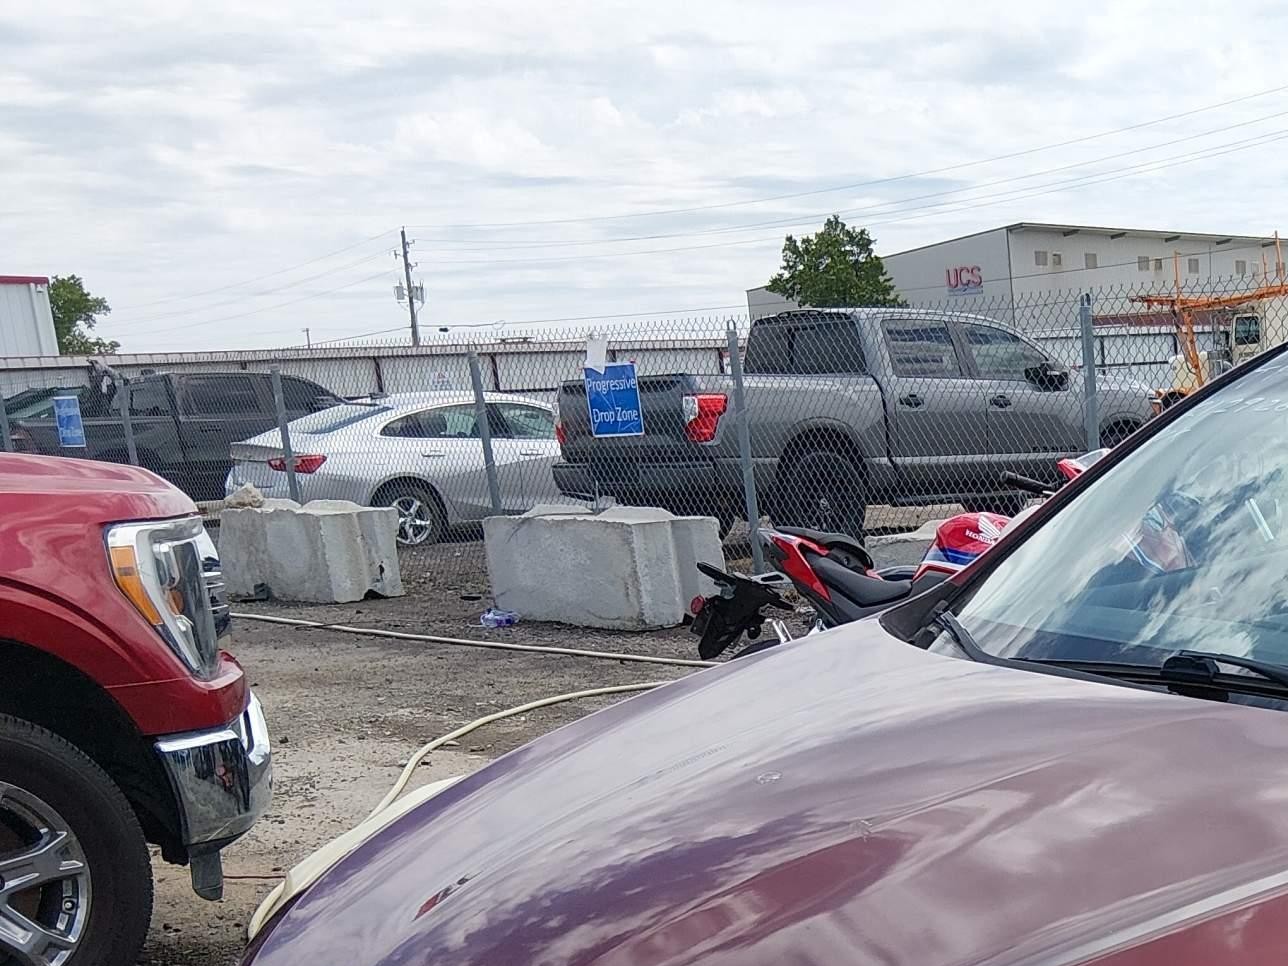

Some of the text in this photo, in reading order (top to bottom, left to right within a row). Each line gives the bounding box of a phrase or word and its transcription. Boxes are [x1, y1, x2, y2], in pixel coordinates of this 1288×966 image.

[946, 265, 983, 289] UCS
[586, 376, 637, 394] Progressive
[593, 407, 639, 424] Drop Zone
[965, 528, 997, 546] HONDA
